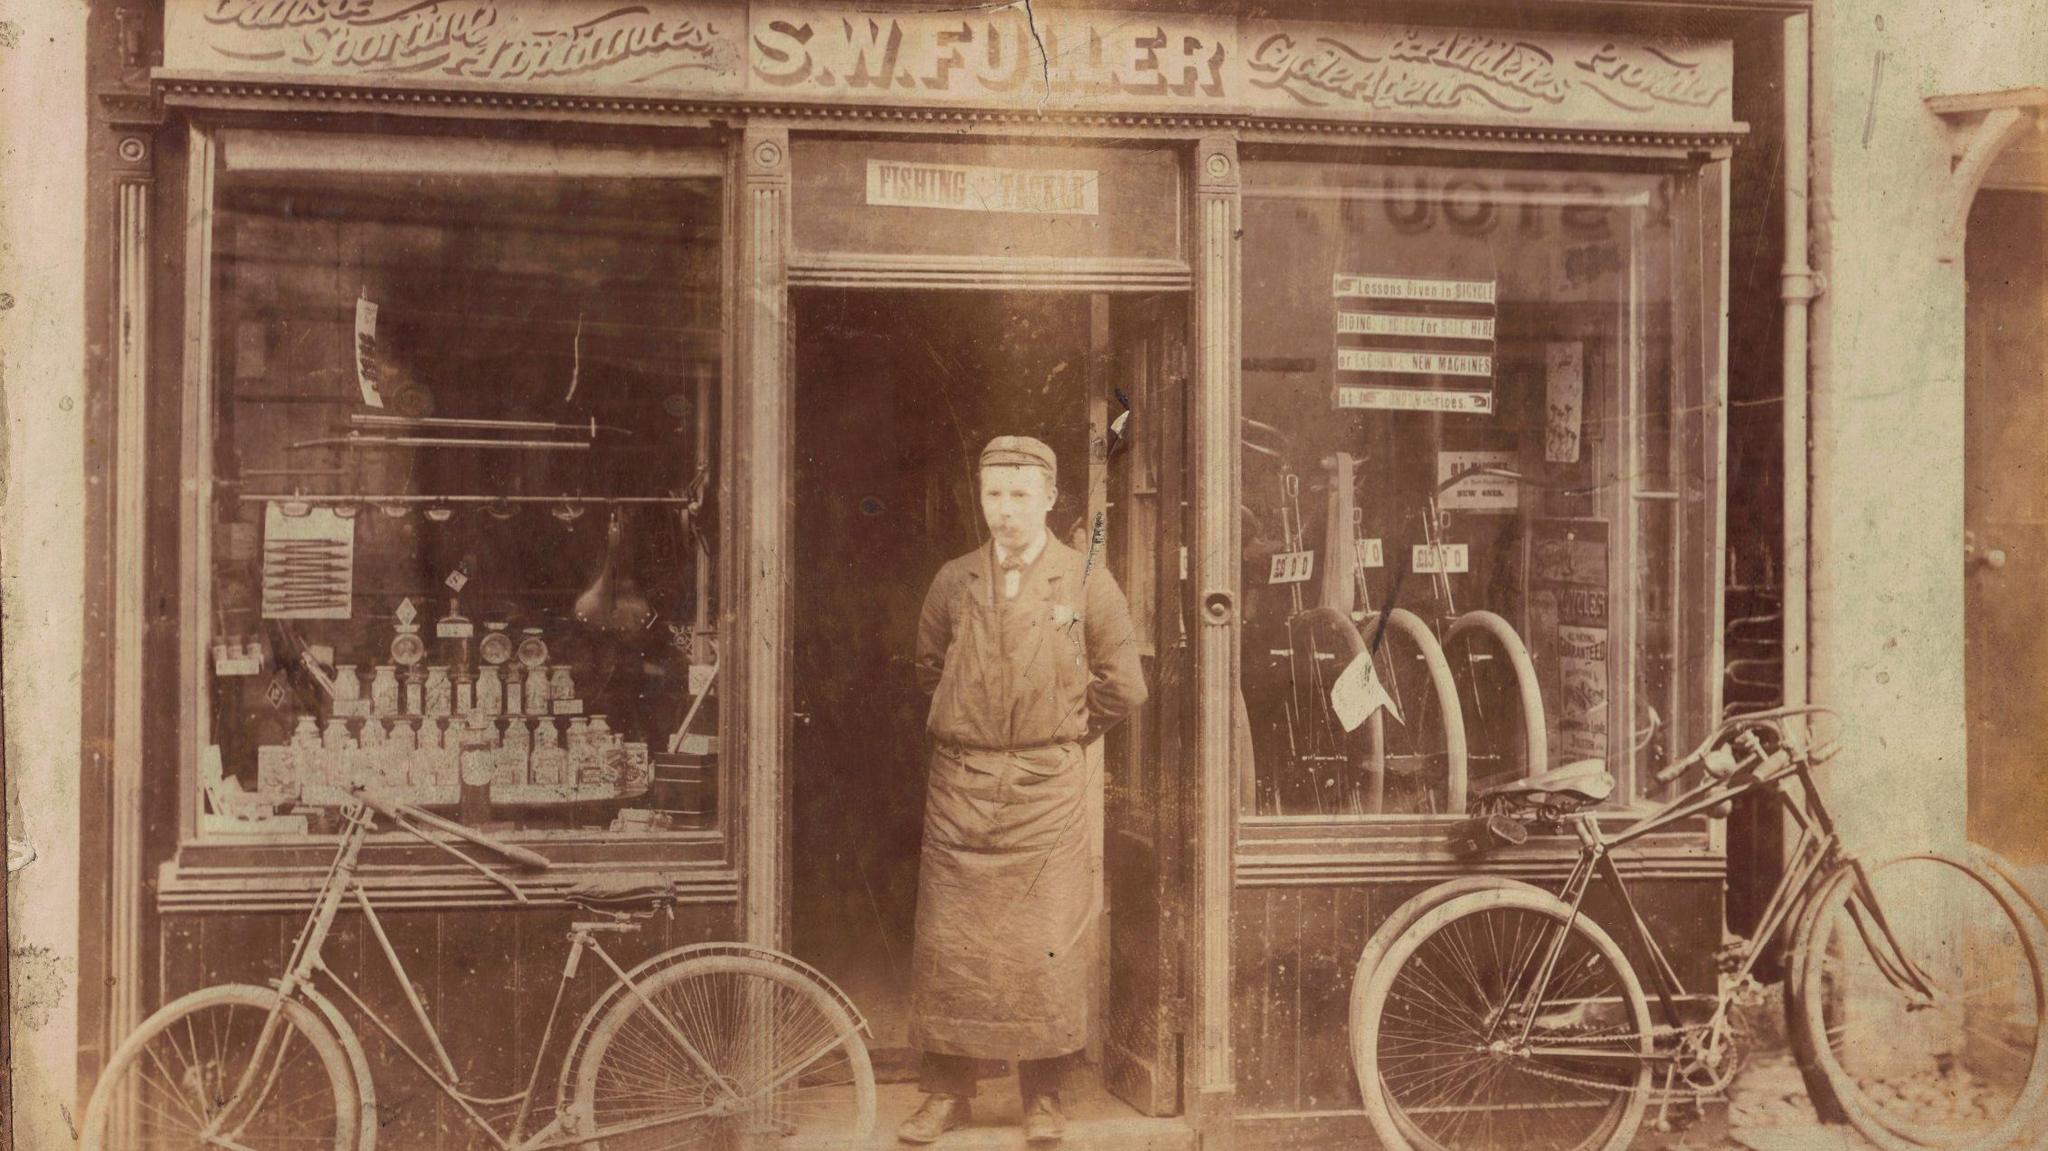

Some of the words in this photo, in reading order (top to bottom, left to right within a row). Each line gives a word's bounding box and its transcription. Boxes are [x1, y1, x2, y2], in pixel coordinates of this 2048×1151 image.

[292, 4, 497, 67] Sporting
[443, 20, 720, 80] Appliances
[878, 165, 966, 203] FISHING
[1358, 279, 1401, 296] Lessons
[1407, 281, 1437, 297] Given
[1441, 283, 1452, 298] in
[1455, 283, 1494, 300] BICYCLE
[1420, 318, 1438, 334] for
[1339, 354, 1351, 368] or
[1412, 355, 1432, 370] NEW
[1438, 357, 1490, 373] MACHINES
